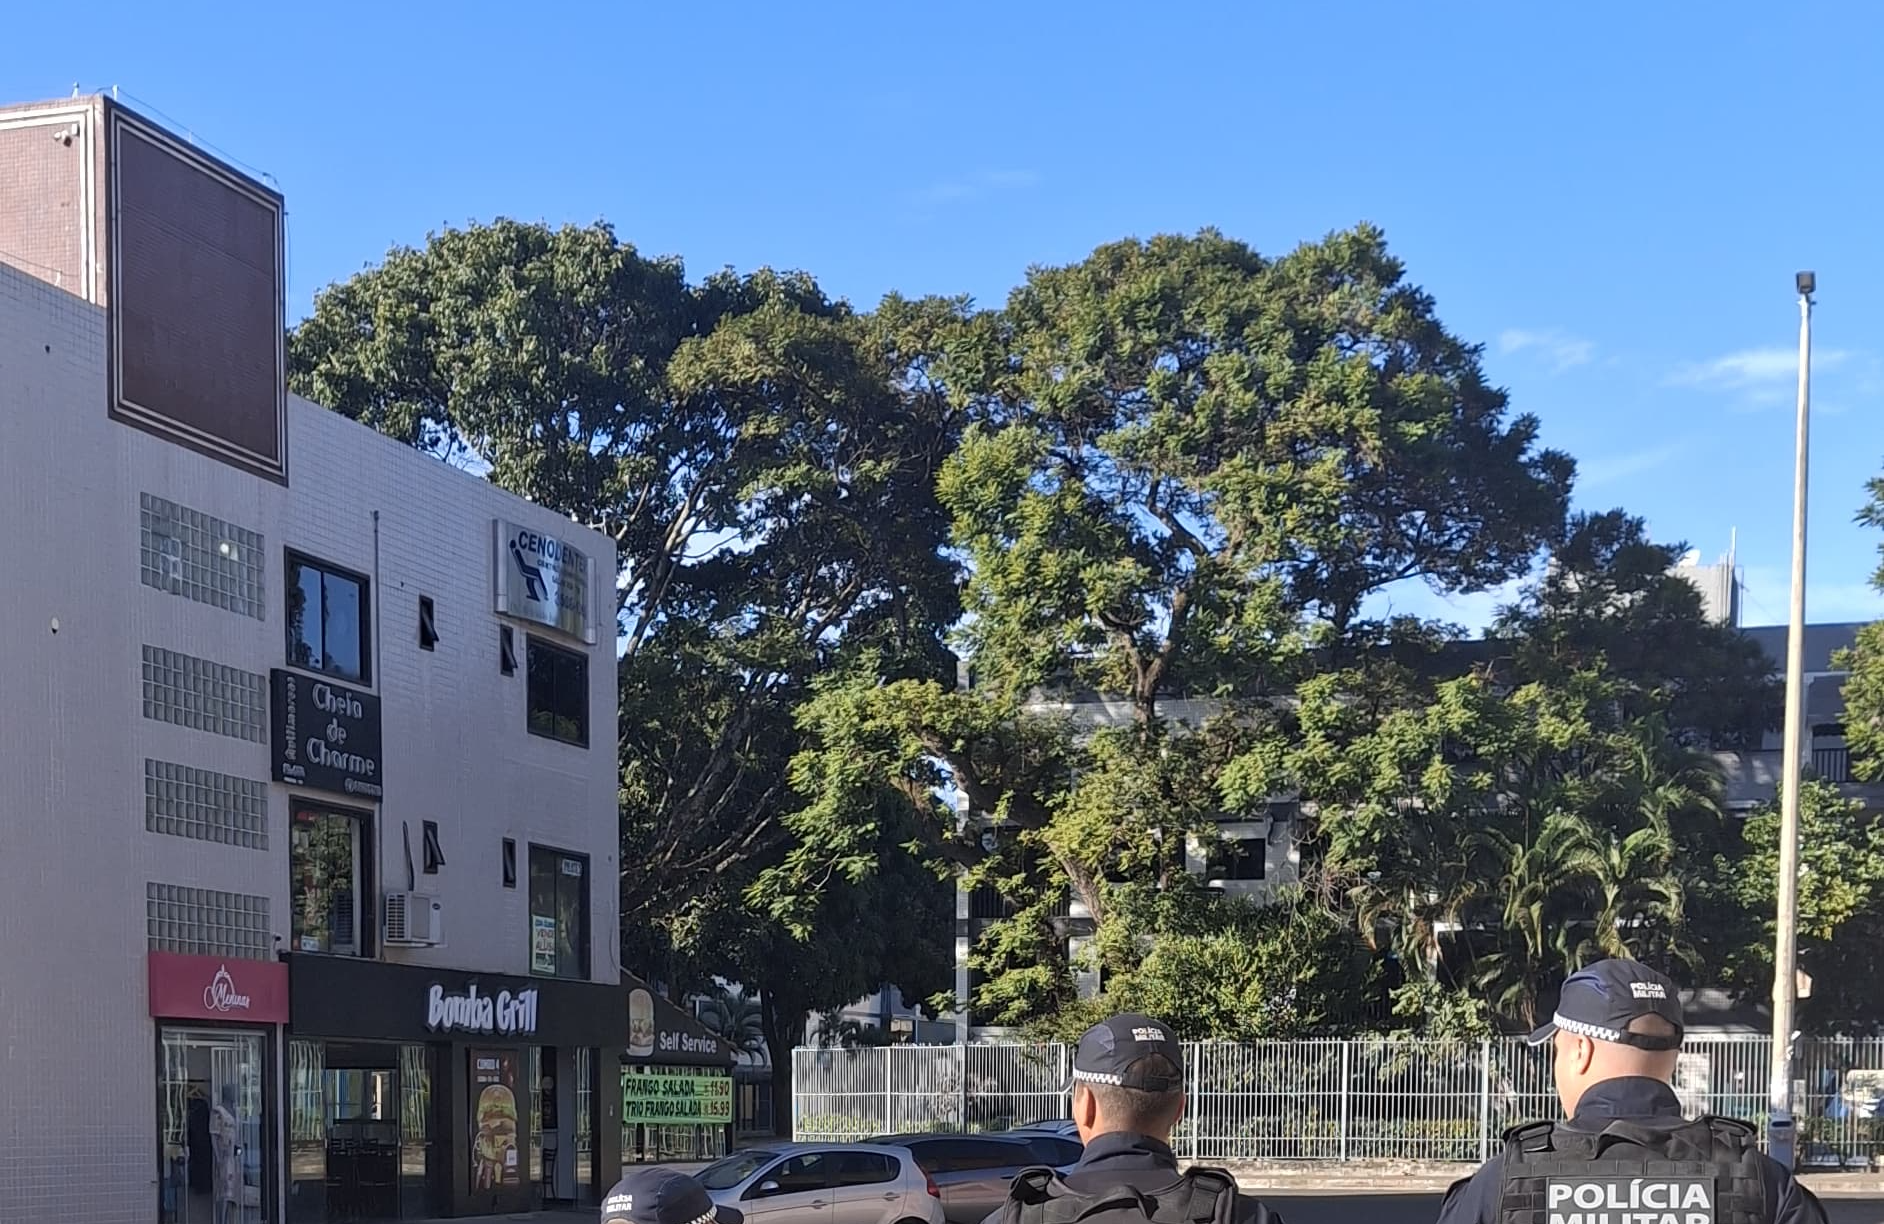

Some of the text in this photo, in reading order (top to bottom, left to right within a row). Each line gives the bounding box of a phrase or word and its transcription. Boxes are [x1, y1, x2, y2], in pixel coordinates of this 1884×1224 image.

[312, 683, 363, 719] Cheia
[326, 718, 347, 745] de
[306, 737, 375, 776] Charme
[428, 984, 538, 1032] Bomba Grill
[660, 1031, 717, 1053] Self Service
[625, 1079, 660, 1097] FRANGO
[662, 1080, 695, 1097] SALADA
[625, 1101, 644, 1117] TRIO
[645, 1101, 675, 1117] FRANGO
[675, 1101, 701, 1117] SALADA
[1549, 1179, 1711, 1209] POLÍCIA
[606, 1202, 632, 1214] MILITAR
